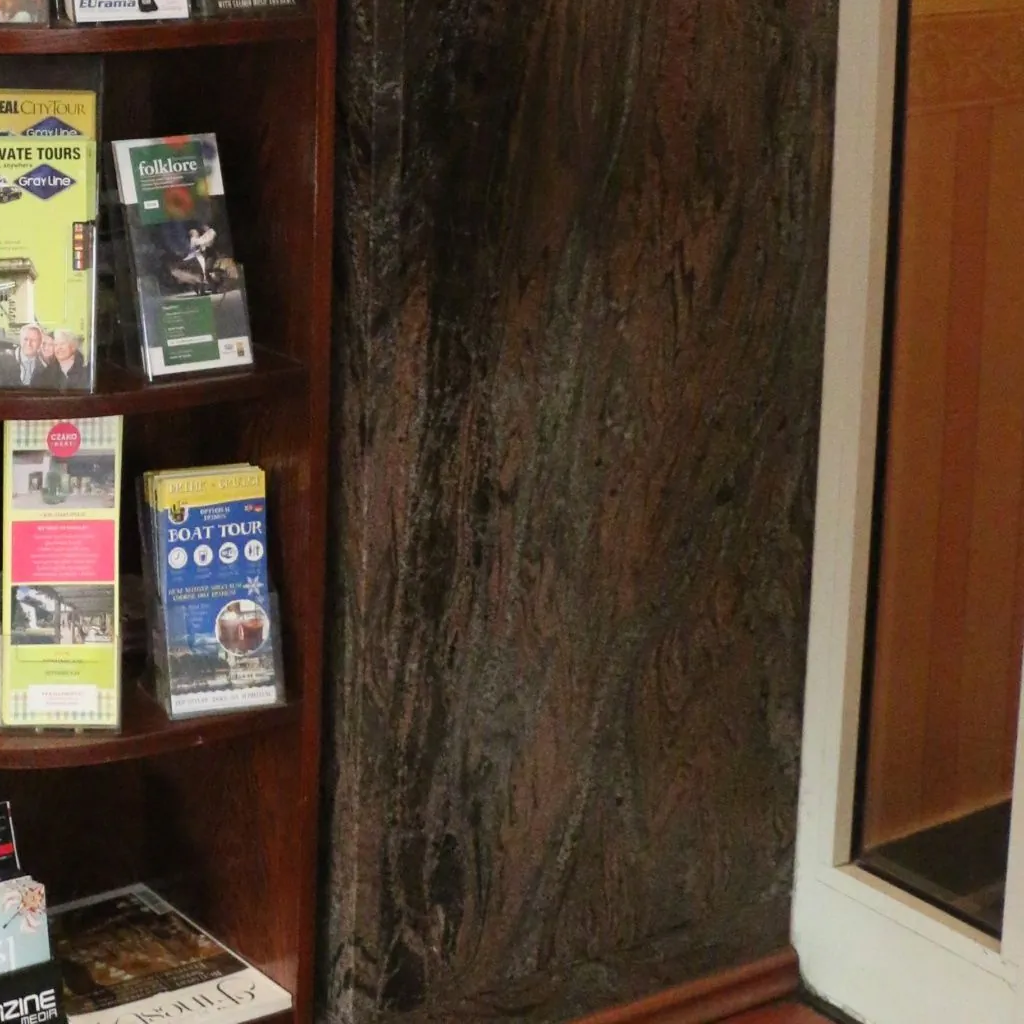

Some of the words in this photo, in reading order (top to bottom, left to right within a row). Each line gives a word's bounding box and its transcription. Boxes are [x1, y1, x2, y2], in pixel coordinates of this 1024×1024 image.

[37, 148, 81, 160] TOURS
[138, 157, 198, 176] folklore
[19, 176, 46, 186] Gray
[48, 176, 71, 186] Line
[168, 526, 214, 542] BOAT
[218, 521, 262, 538] TOUR
[21, 1008, 58, 1024] MEDIA
